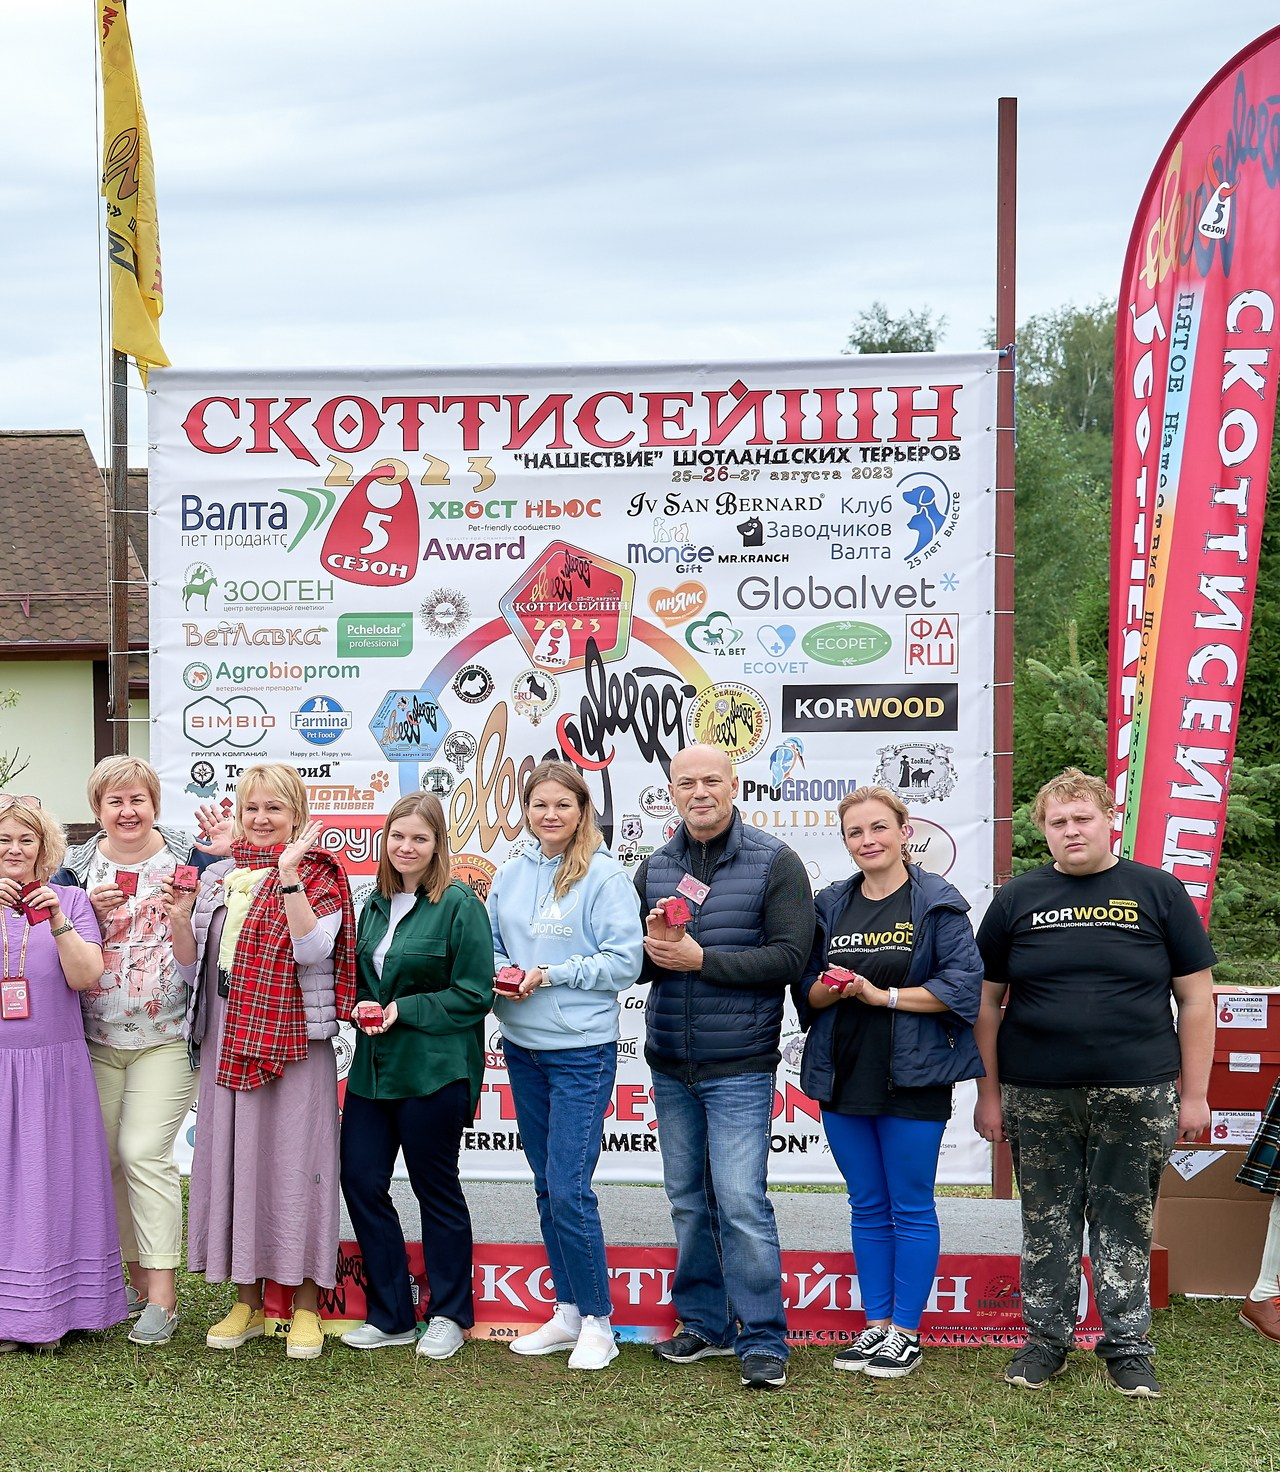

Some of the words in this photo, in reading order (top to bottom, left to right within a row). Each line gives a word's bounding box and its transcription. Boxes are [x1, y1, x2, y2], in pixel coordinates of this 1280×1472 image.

[1213, 203, 1226, 225] 5
[181, 379, 962, 466] СКОТТИСЕЙШН
[673, 447, 852, 465] ШОТЛАНДСКИХ
[859, 445, 960, 462] ТЕРЬЕРОВ
[770, 470, 842, 482] августа
[852, 467, 893, 479] 2023
[182, 494, 287, 531] Валта
[427, 499, 518, 520] ХВОСТ
[841, 496, 892, 518] Клуб
[360, 511, 393, 554] 5
[766, 521, 891, 540] Заводчиков
[907, 556, 922, 570] 25
[923, 541, 942, 559] лет
[944, 492, 960, 537] вместе
[181, 534, 207, 547] пет
[422, 536, 525, 561] Award
[718, 554, 789, 563] MR.KRANCH
[831, 542, 891, 561] Валта
[327, 554, 409, 578] СЕЗОН
[676, 564, 703, 574] Gift
[223, 580, 334, 602] ЗООГЕН
[737, 575, 936, 610] Globalvet
[245, 604, 293, 612] ветеринарной
[347, 624, 402, 635] Pchelodar
[349, 638, 399, 649] professional
[547, 639, 561, 656] 5
[816, 637, 877, 650] ECOPET
[216, 661, 360, 684] Agrobioprom
[744, 662, 808, 674] ECOVET
[795, 697, 944, 719] KORWOOD
[191, 716, 276, 728] SIMBIO
[294, 714, 348, 727] Farmina
[748, 710, 763, 747] SESSION
[333, 802, 375, 811] RUBBER
[1032, 906, 1139, 926] KORWOOD
[1219, 1008, 1234, 1023] 6
[1214, 1124, 1228, 1139] 8
